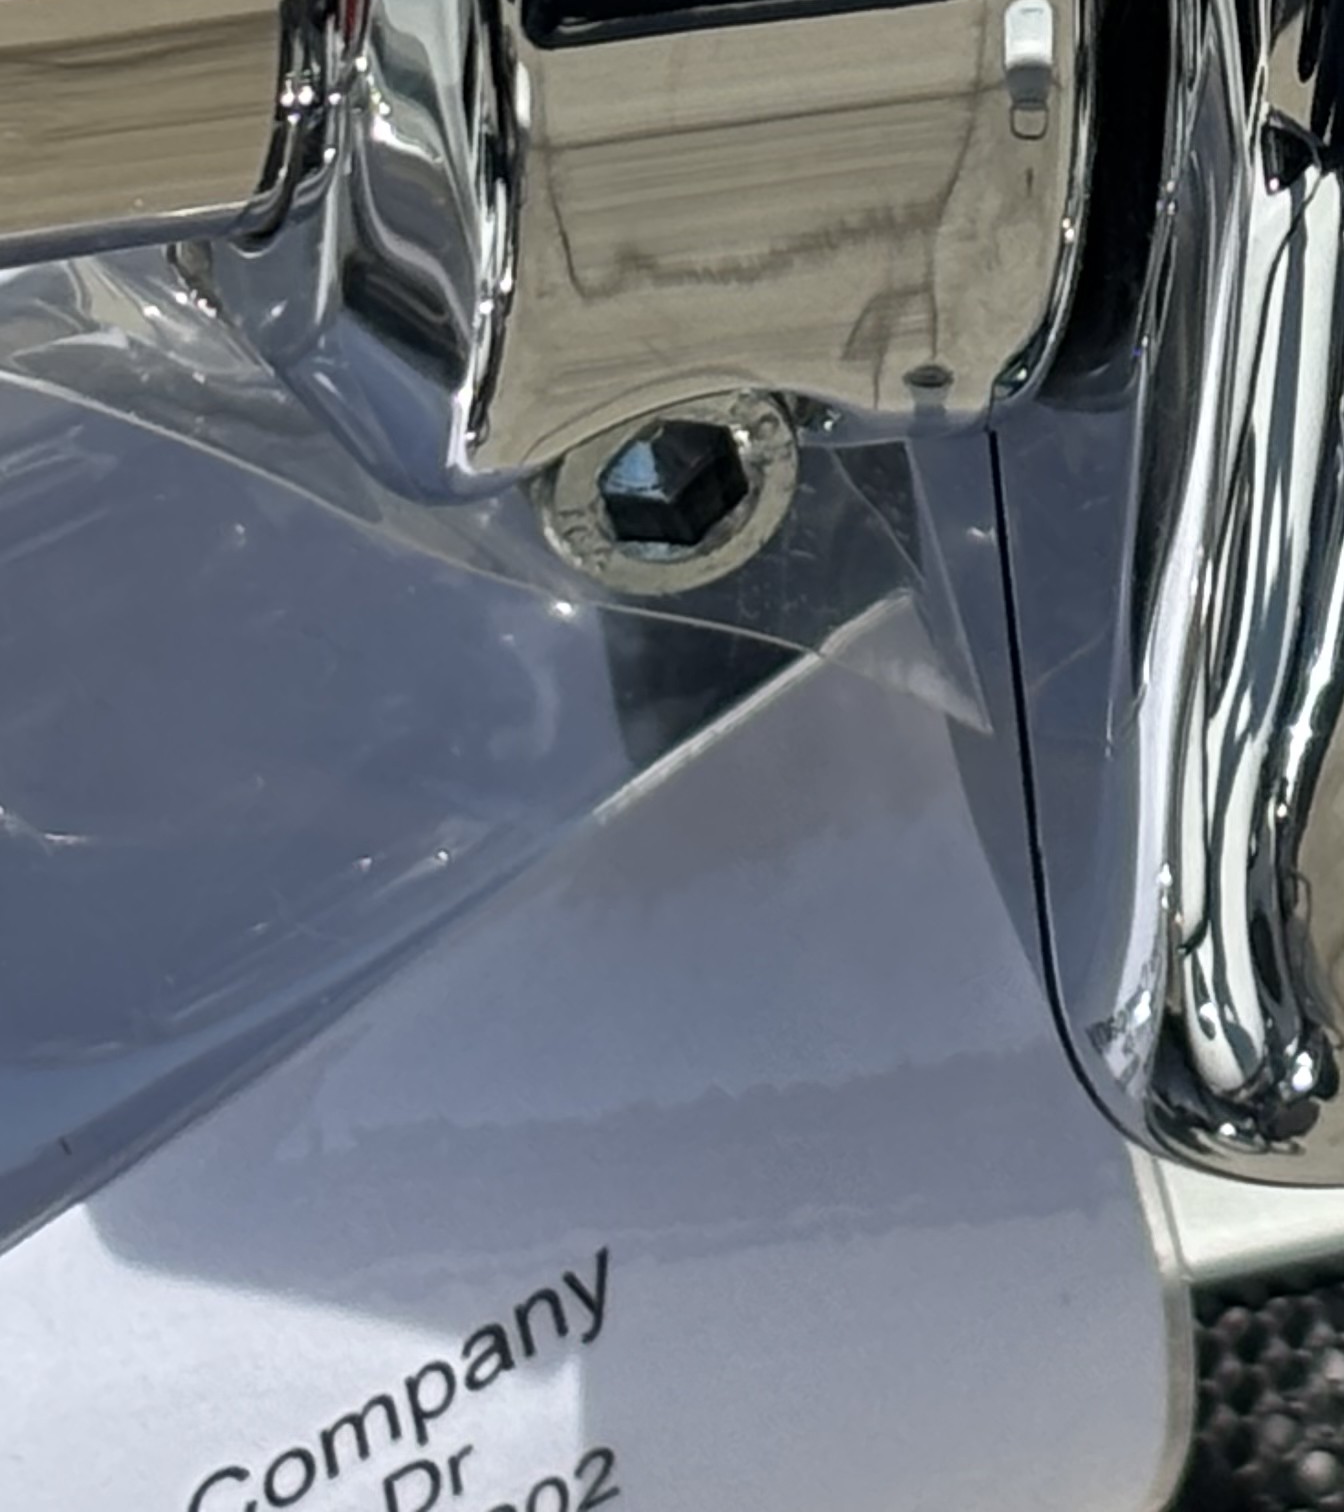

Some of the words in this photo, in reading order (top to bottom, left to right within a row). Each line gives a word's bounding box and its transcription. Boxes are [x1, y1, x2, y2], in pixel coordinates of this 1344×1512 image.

[187, 1245, 609, 1512] Company
[383, 1444, 474, 1512] Dr
[487, 1446, 620, 1512] 02
